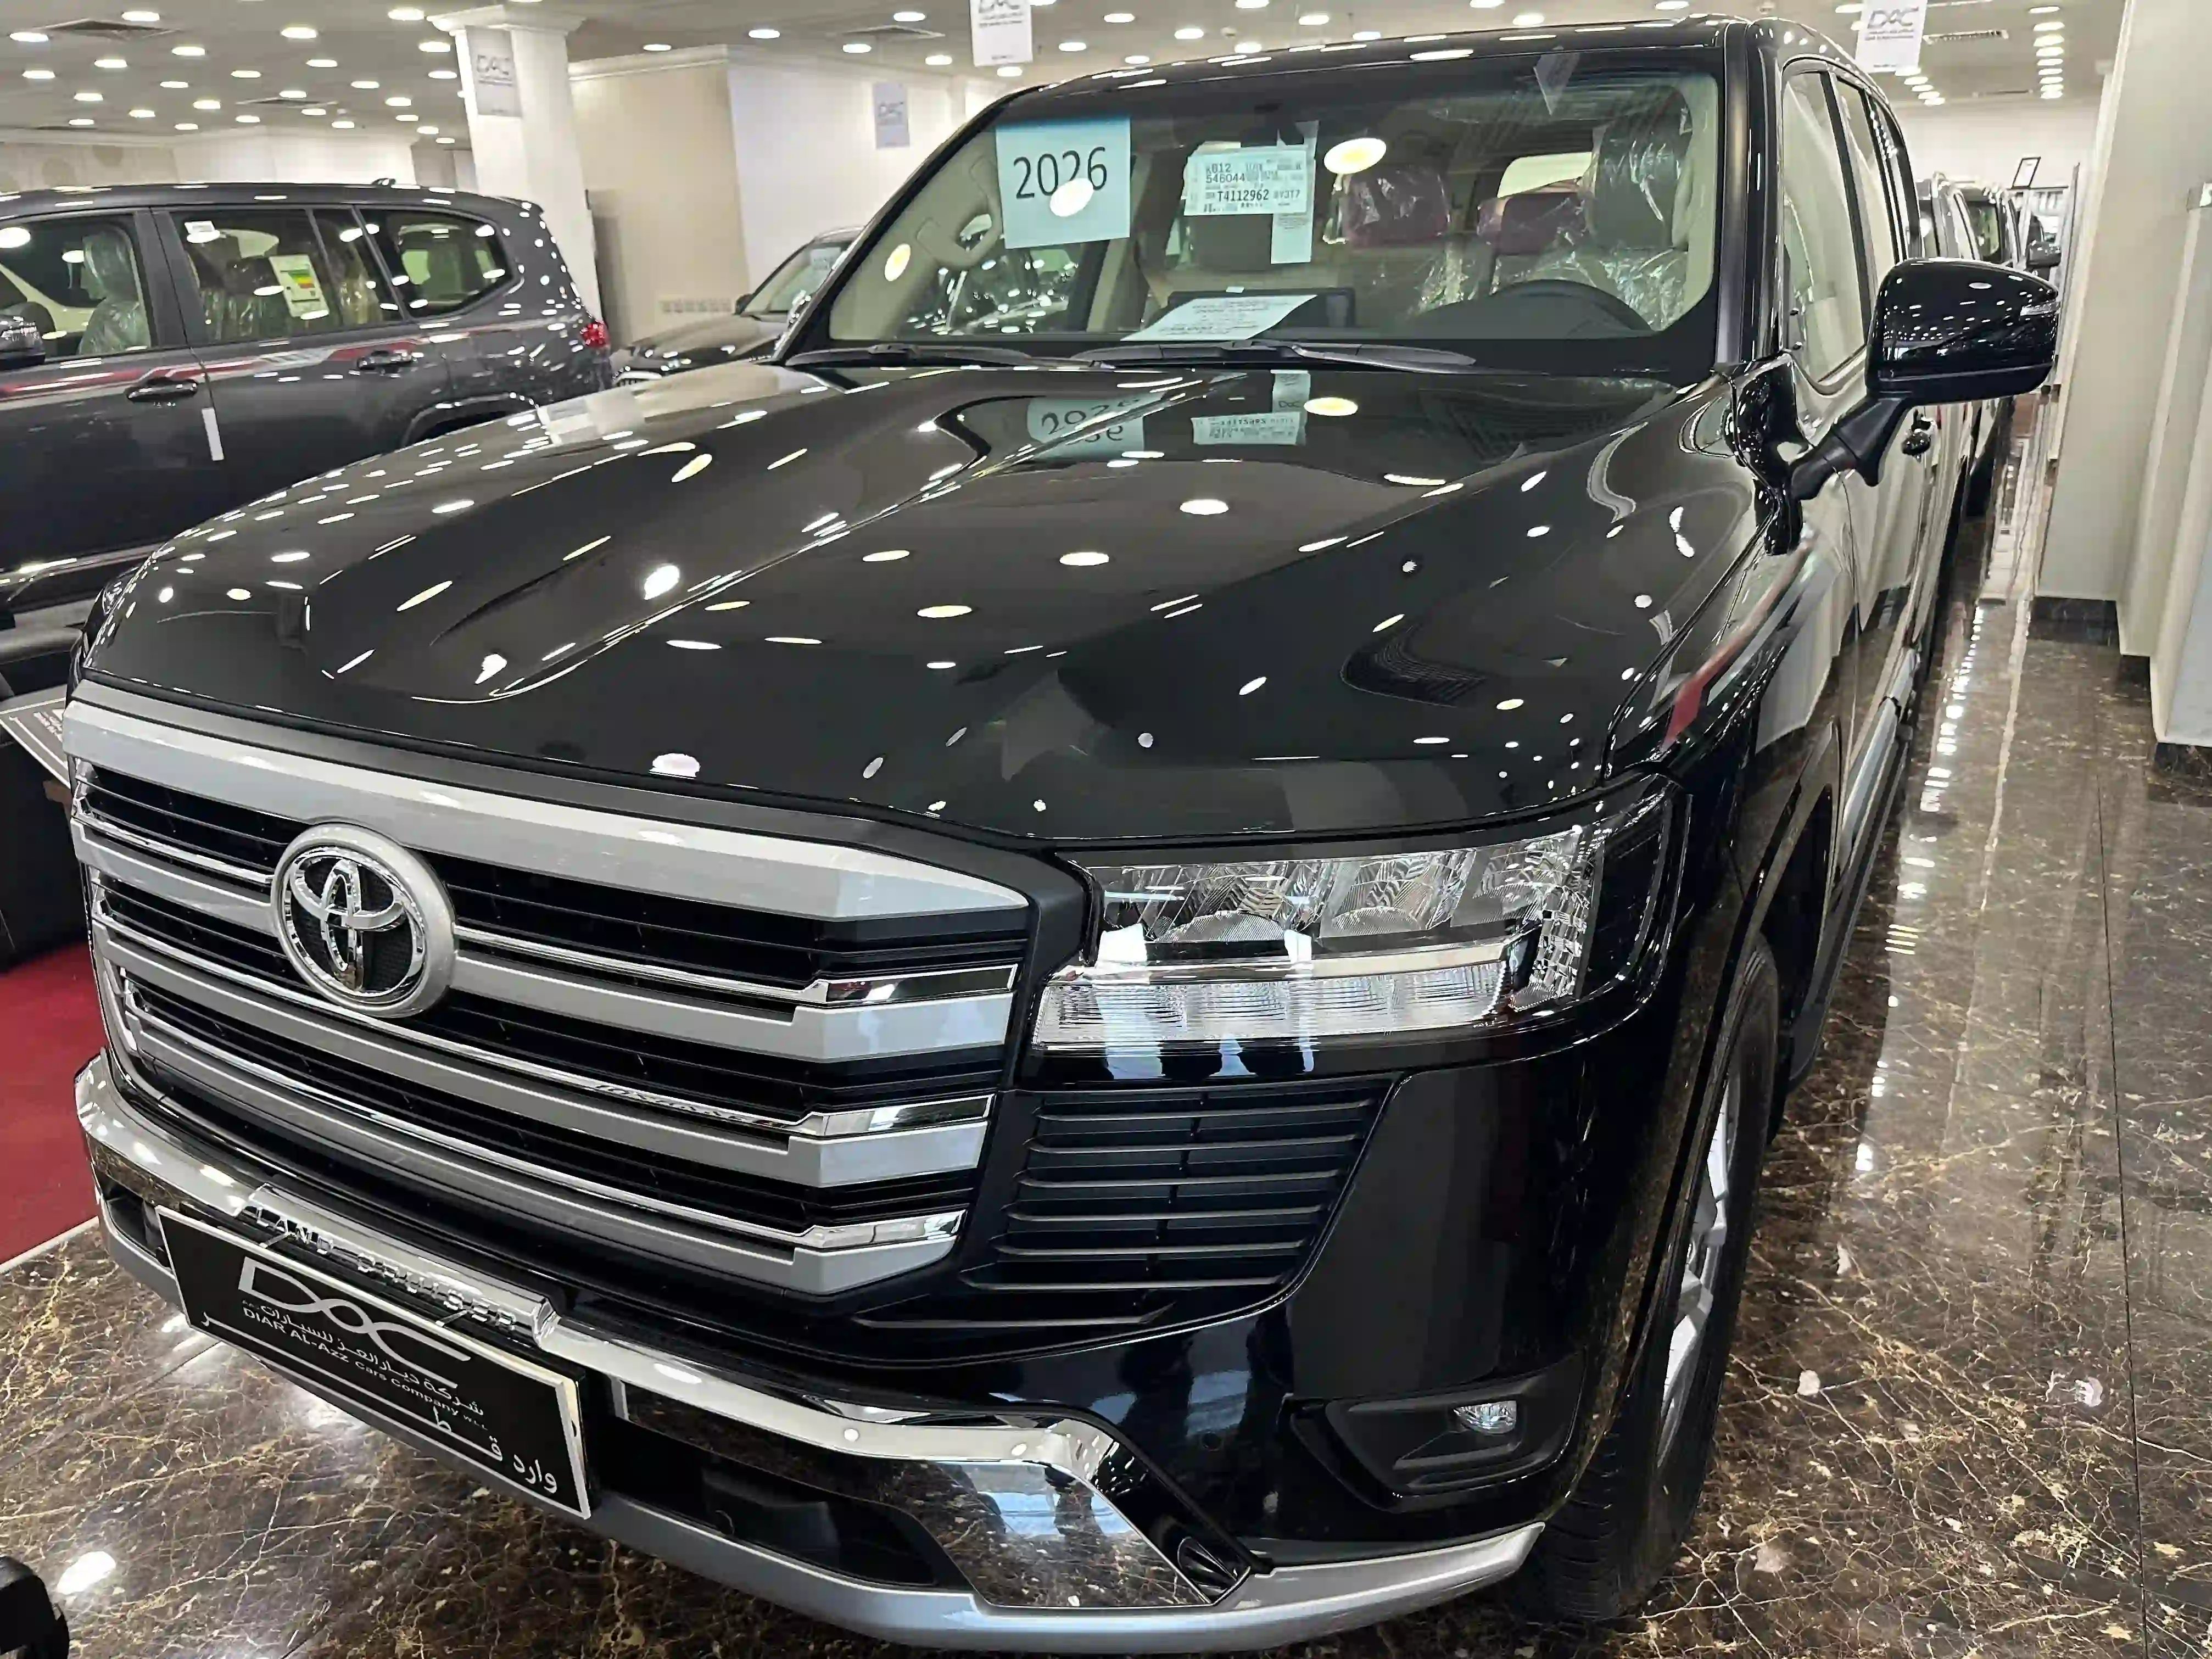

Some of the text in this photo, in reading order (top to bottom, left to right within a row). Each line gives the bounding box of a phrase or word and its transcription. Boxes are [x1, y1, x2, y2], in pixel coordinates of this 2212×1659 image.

[1014, 146, 1107, 199] 2026
[1217, 189, 1269, 202] T4112962
[256, 1205, 333, 1255] LAND
[243, 1306, 287, 1334] DIAR
[391, 1378, 459, 1416] Company
[261, 1305, 484, 1416] شركة ديار العز للسيارات
[513, 1454, 557, 1494] وارد
